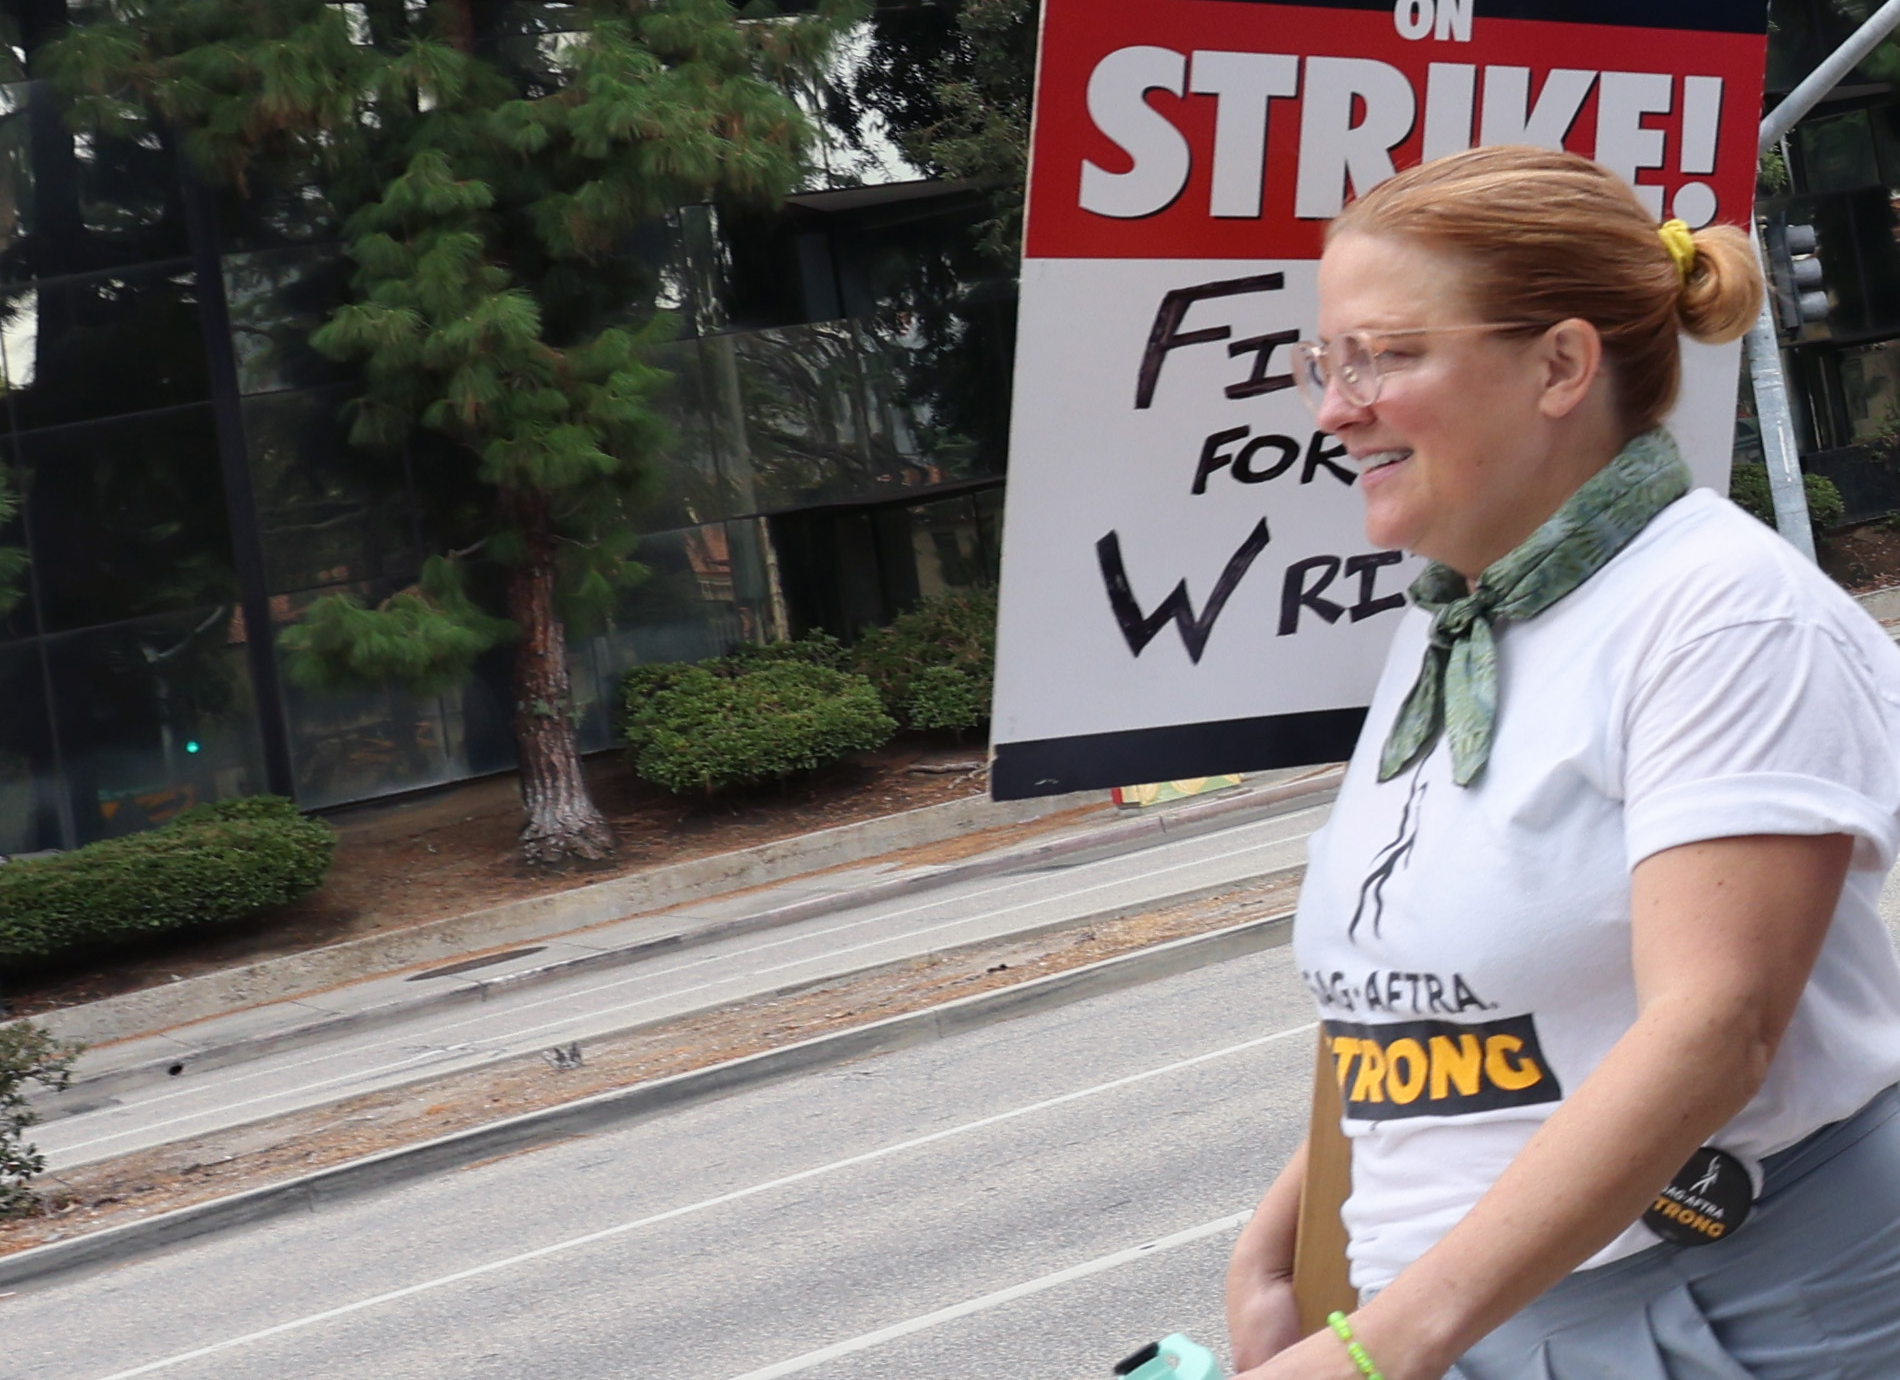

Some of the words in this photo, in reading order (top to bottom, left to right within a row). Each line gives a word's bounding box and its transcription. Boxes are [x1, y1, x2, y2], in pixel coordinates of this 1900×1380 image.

[1190, 422, 1356, 497] FOR
[1326, 1033, 1543, 1106] TRONG
[1652, 1196, 1727, 1238] TRONG
